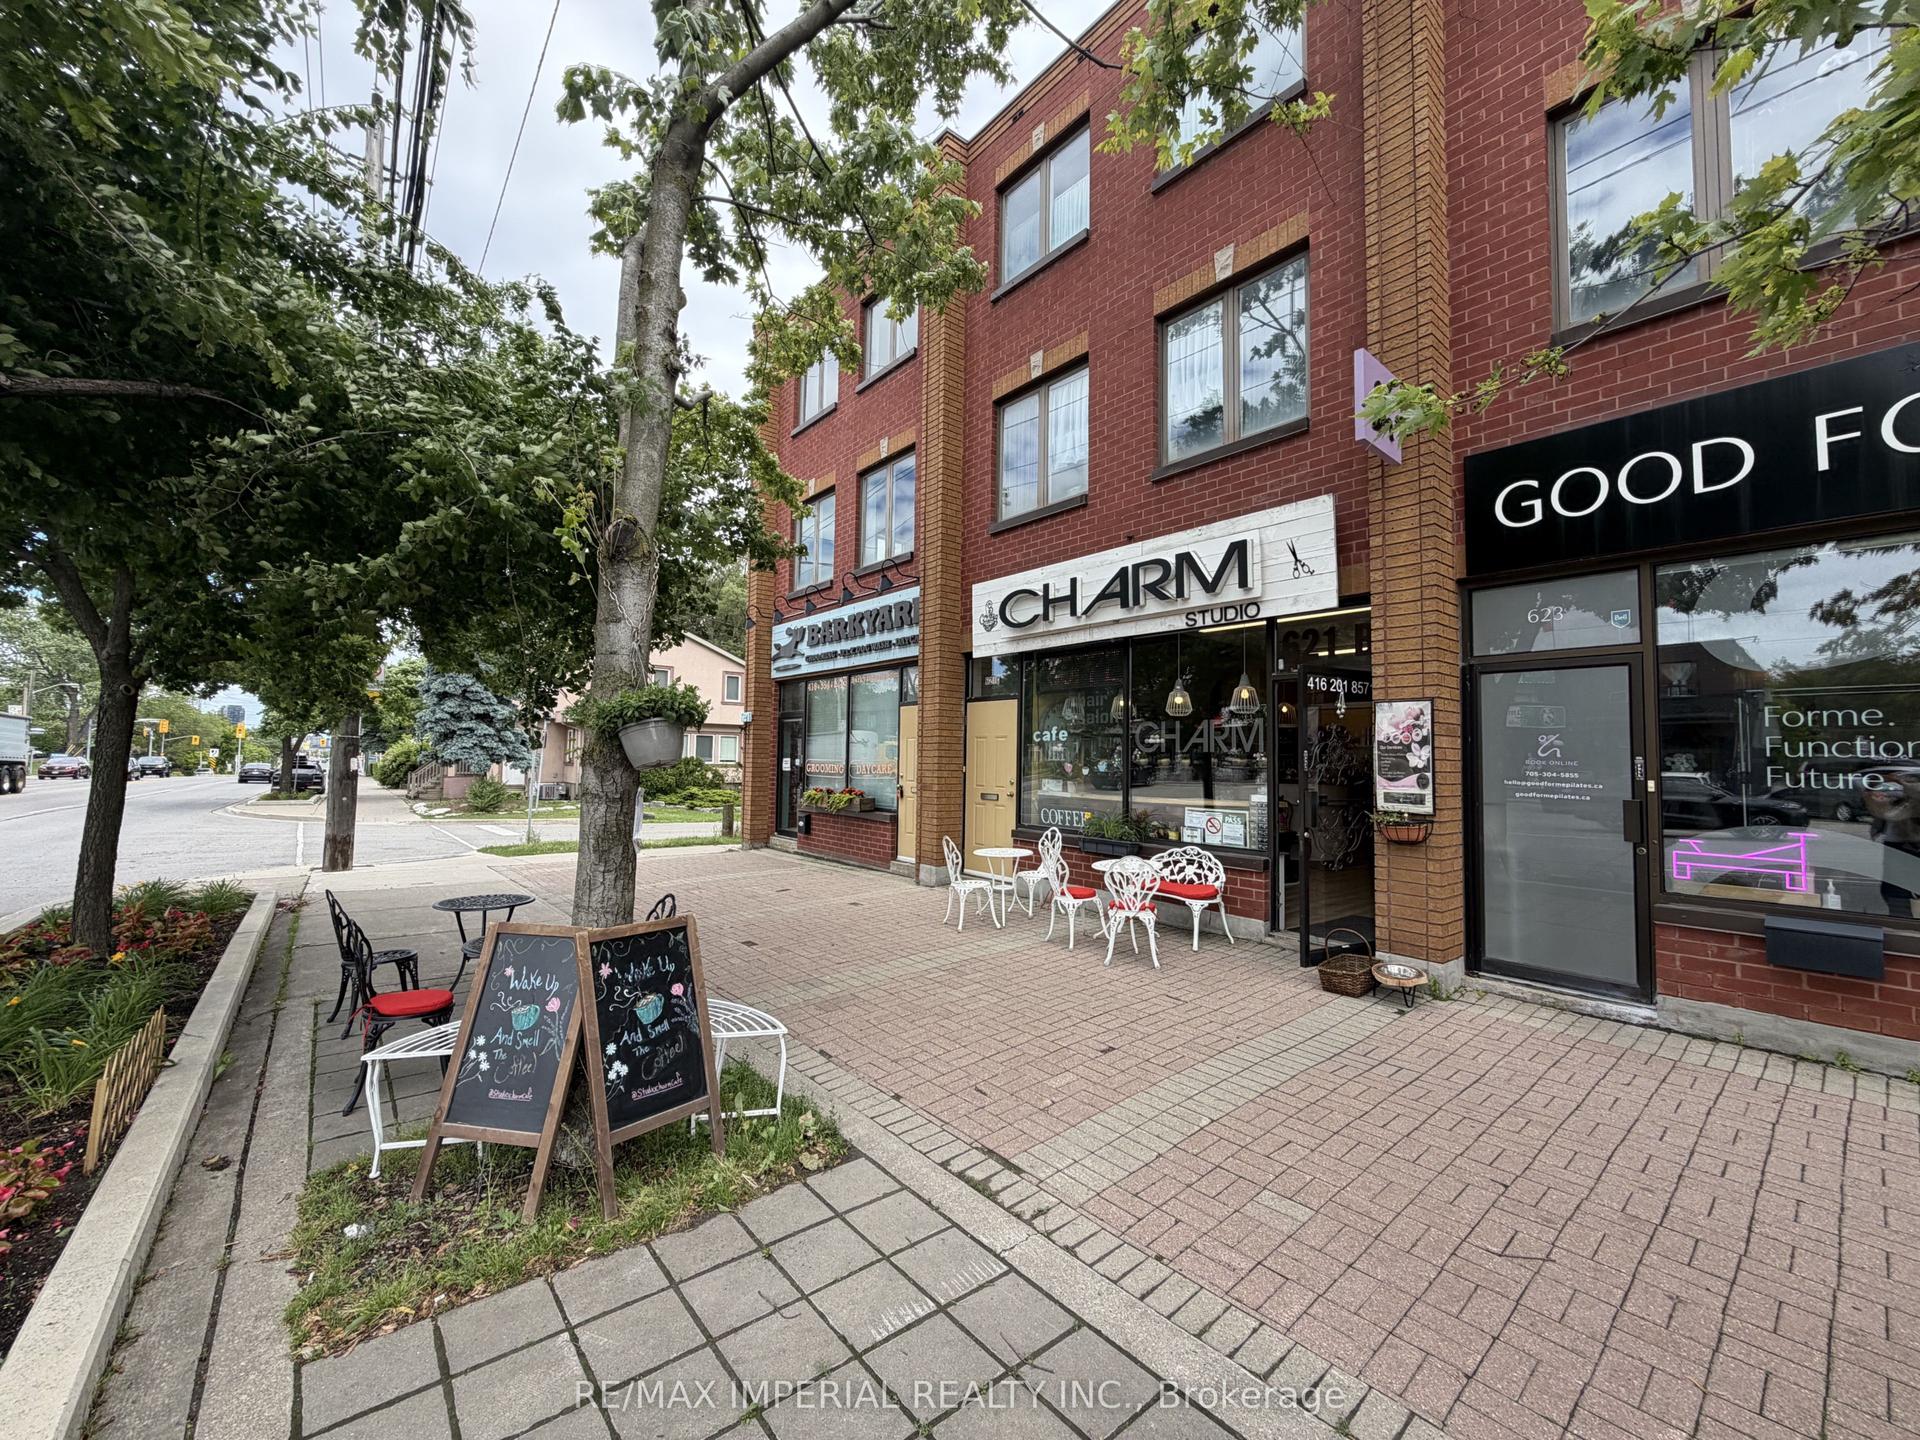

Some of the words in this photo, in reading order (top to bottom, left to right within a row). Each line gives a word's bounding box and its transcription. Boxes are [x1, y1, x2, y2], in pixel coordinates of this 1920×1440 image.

[1494, 437, 1755, 527] GOOD
[999, 539, 1250, 628] CHARM
[1185, 602, 1260, 627] STUDIO
[1527, 606, 1564, 624] 623
[1283, 626, 1336, 656] 621
[1307, 676, 1328, 691] 416
[1330, 678, 1348, 694] 201
[1351, 681, 1372, 695] 857
[1764, 705, 1895, 728] Forme.
[1033, 726, 1068, 742] cafe
[1135, 717, 1264, 753] CHARM
[806, 763, 845, 774] GROOMING
[856, 763, 892, 775] DAYCARE
[1503, 780, 1603, 789] hello@goodformepilates.ca
[1515, 792, 1591, 801] goodformepilates.ca
[1225, 815, 1242, 825] PASS
[657, 955, 675, 983] Up
[545, 973, 559, 1001] Up
[490, 1027, 514, 1046] And
[515, 1029, 540, 1050] Smell
[620, 1027, 643, 1046] And
[647, 1019, 670, 1039] Smell
[493, 1048, 507, 1060] The
[632, 1045, 650, 1057] The
